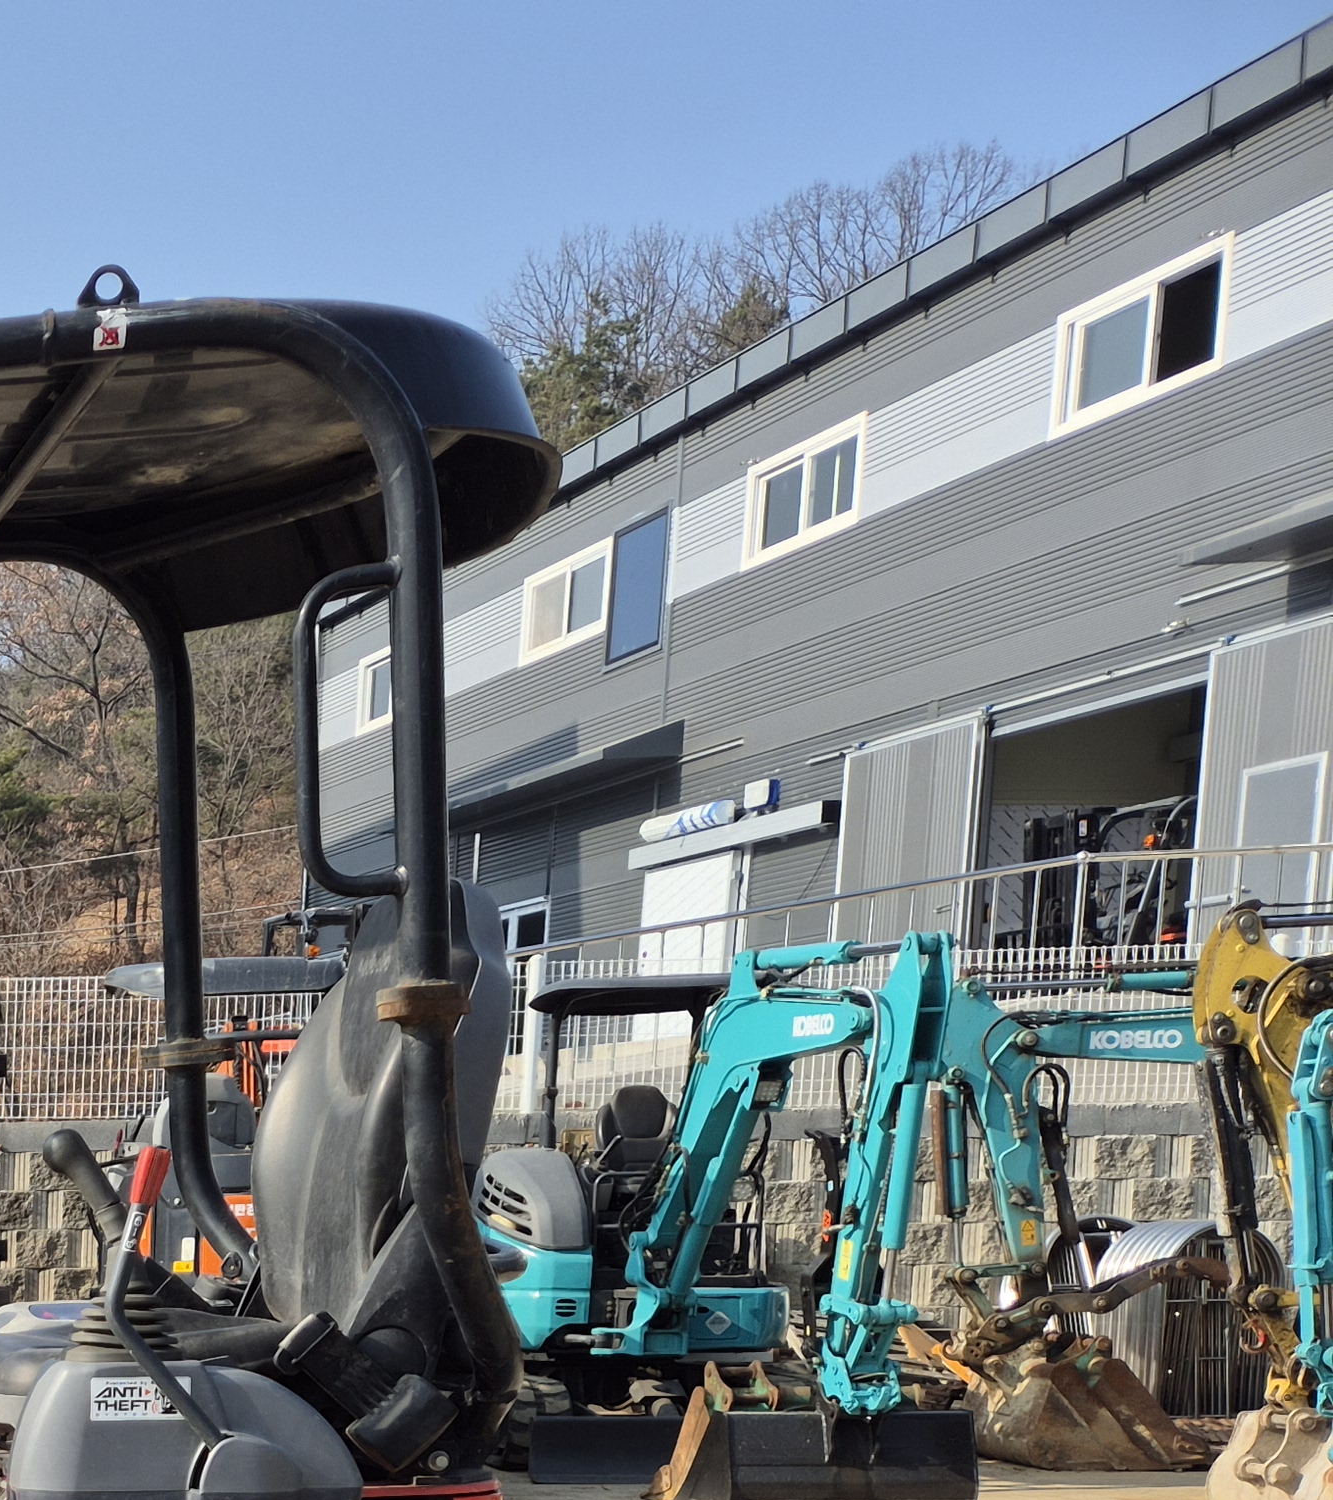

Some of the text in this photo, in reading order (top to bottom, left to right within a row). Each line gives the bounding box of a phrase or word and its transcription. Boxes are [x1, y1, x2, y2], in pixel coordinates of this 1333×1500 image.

[792, 1012, 835, 1037] KOBELCO
[1089, 1029, 1183, 1050] KOBELCO
[95, 1386, 143, 1398] ANTI
[94, 1400, 152, 1411] THEFT
